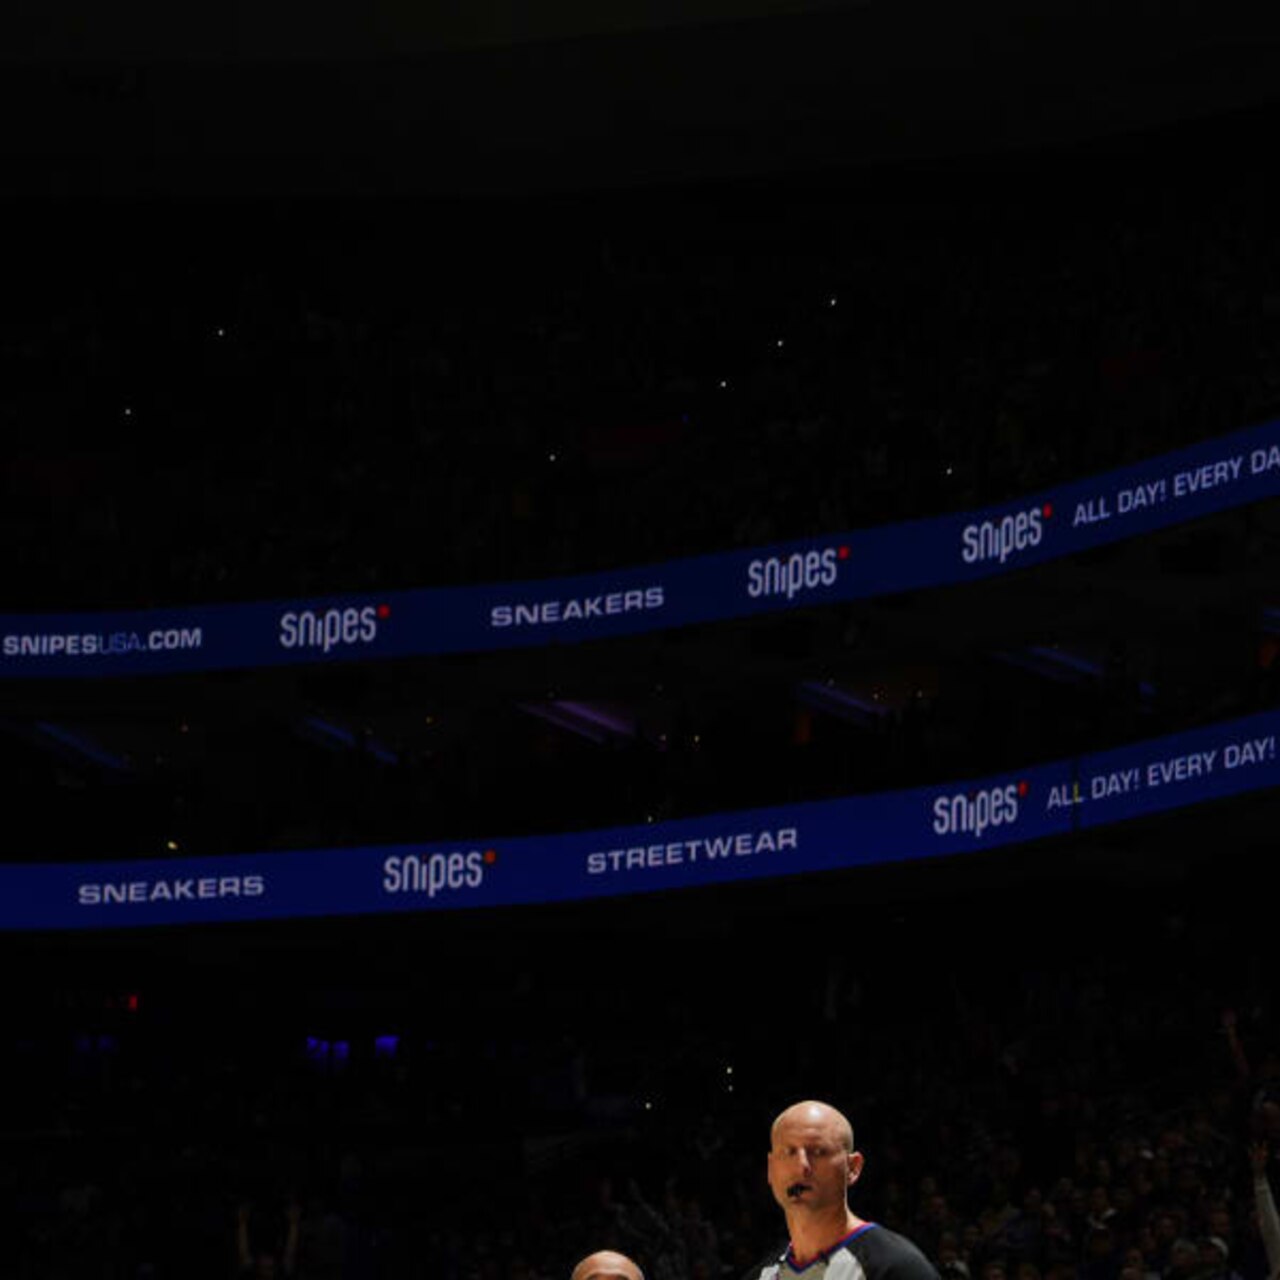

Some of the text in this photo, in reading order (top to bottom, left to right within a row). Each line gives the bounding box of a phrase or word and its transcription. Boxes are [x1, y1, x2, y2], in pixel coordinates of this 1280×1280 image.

[1073, 498, 1110, 526] ALL
[1118, 480, 1165, 513] DAY!
[1174, 457, 1242, 496] EVERY
[963, 508, 1041, 563] snipes
[748, 549, 836, 598] snipes
[280, 607, 376, 652] snipes
[492, 588, 663, 626] SNEAKERS
[3, 628, 202, 655] SNIPESUSA.COM
[1048, 737, 1276, 809] ALL DAY! EVERY DAY!
[934, 785, 1017, 837] snipes
[588, 828, 796, 873] STREETWEAR
[79, 876, 263, 904] SNEAKERS
[384, 852, 482, 897] snipes
